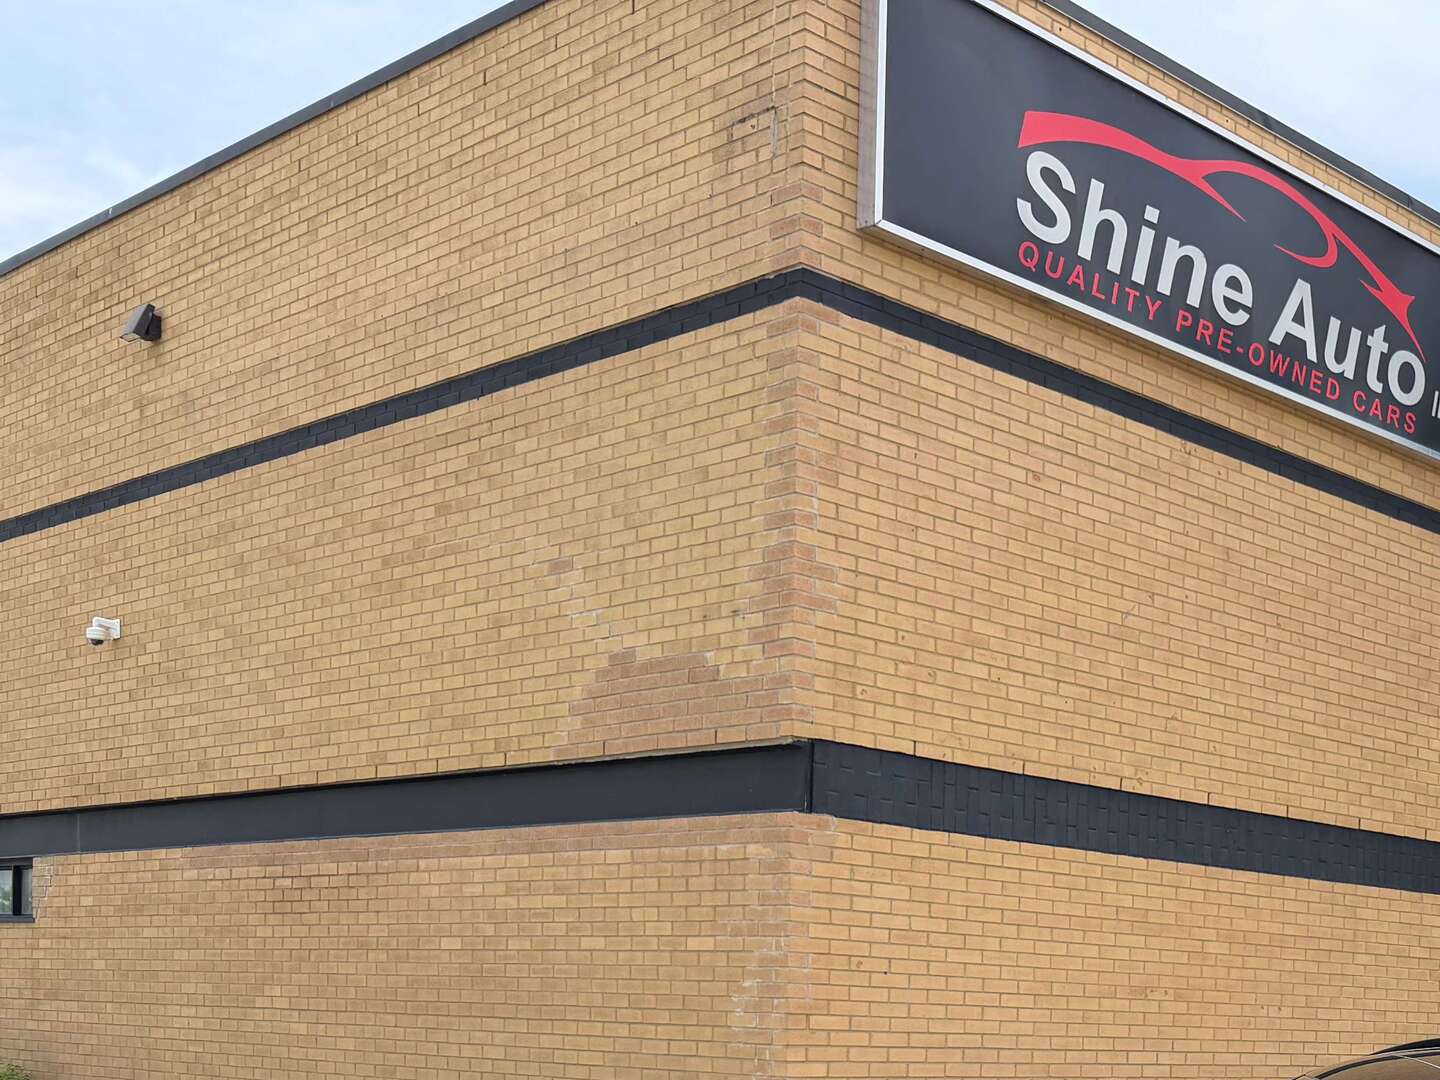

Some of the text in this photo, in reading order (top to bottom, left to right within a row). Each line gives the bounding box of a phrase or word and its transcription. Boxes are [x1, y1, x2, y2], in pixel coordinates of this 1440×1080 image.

[1016, 150, 1253, 326] Shine
[1268, 278, 1426, 406] Auto
[1018, 240, 1417, 434] QUALITY PRE-OWNED CARS
